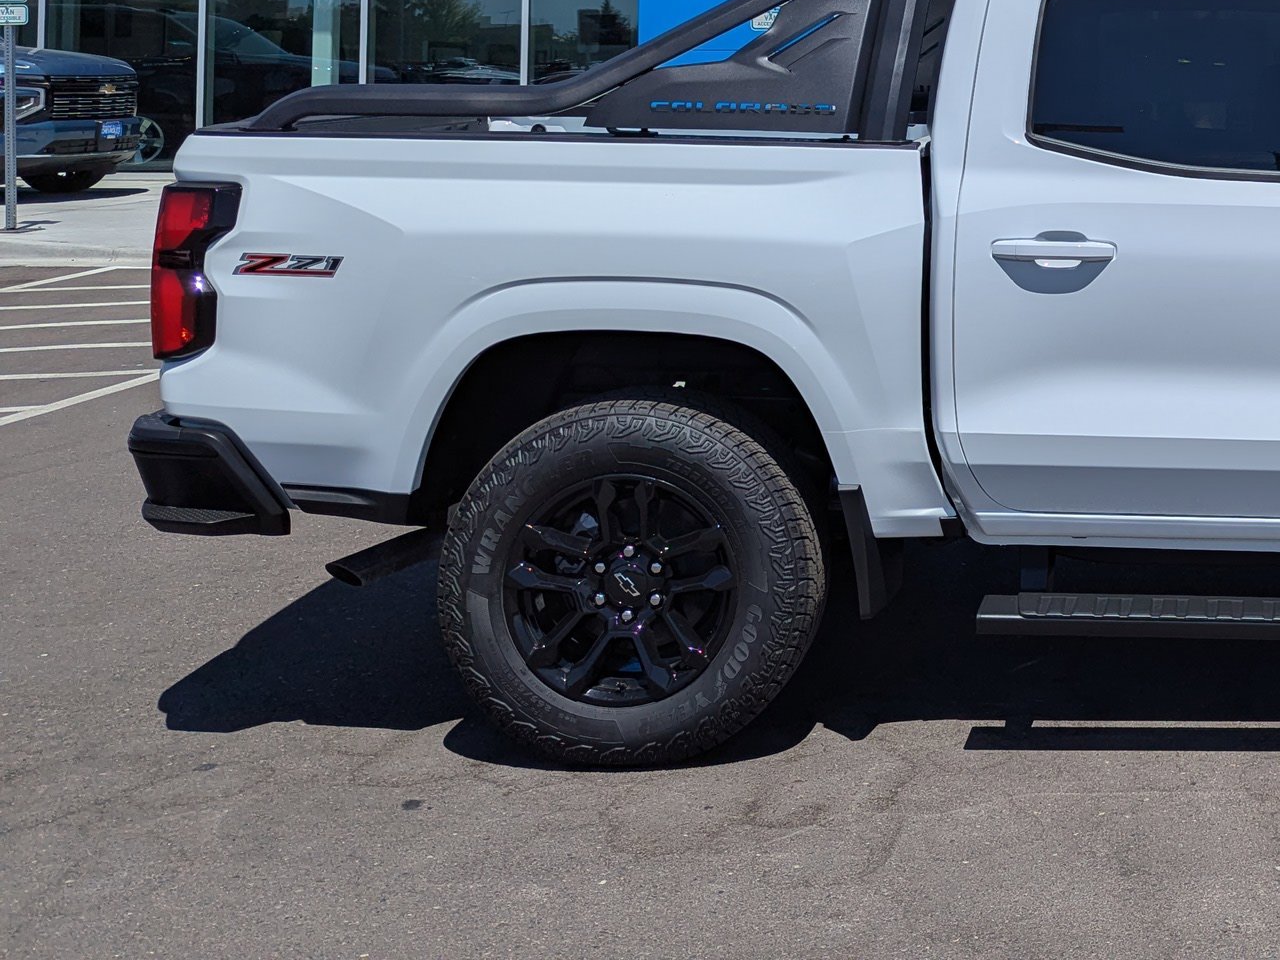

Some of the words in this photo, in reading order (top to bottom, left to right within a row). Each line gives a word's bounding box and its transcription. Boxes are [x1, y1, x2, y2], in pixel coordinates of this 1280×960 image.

[0, 8, 15, 16] VAN
[650, 100, 837, 116] COLORADO
[232, 252, 345, 279] Z71
